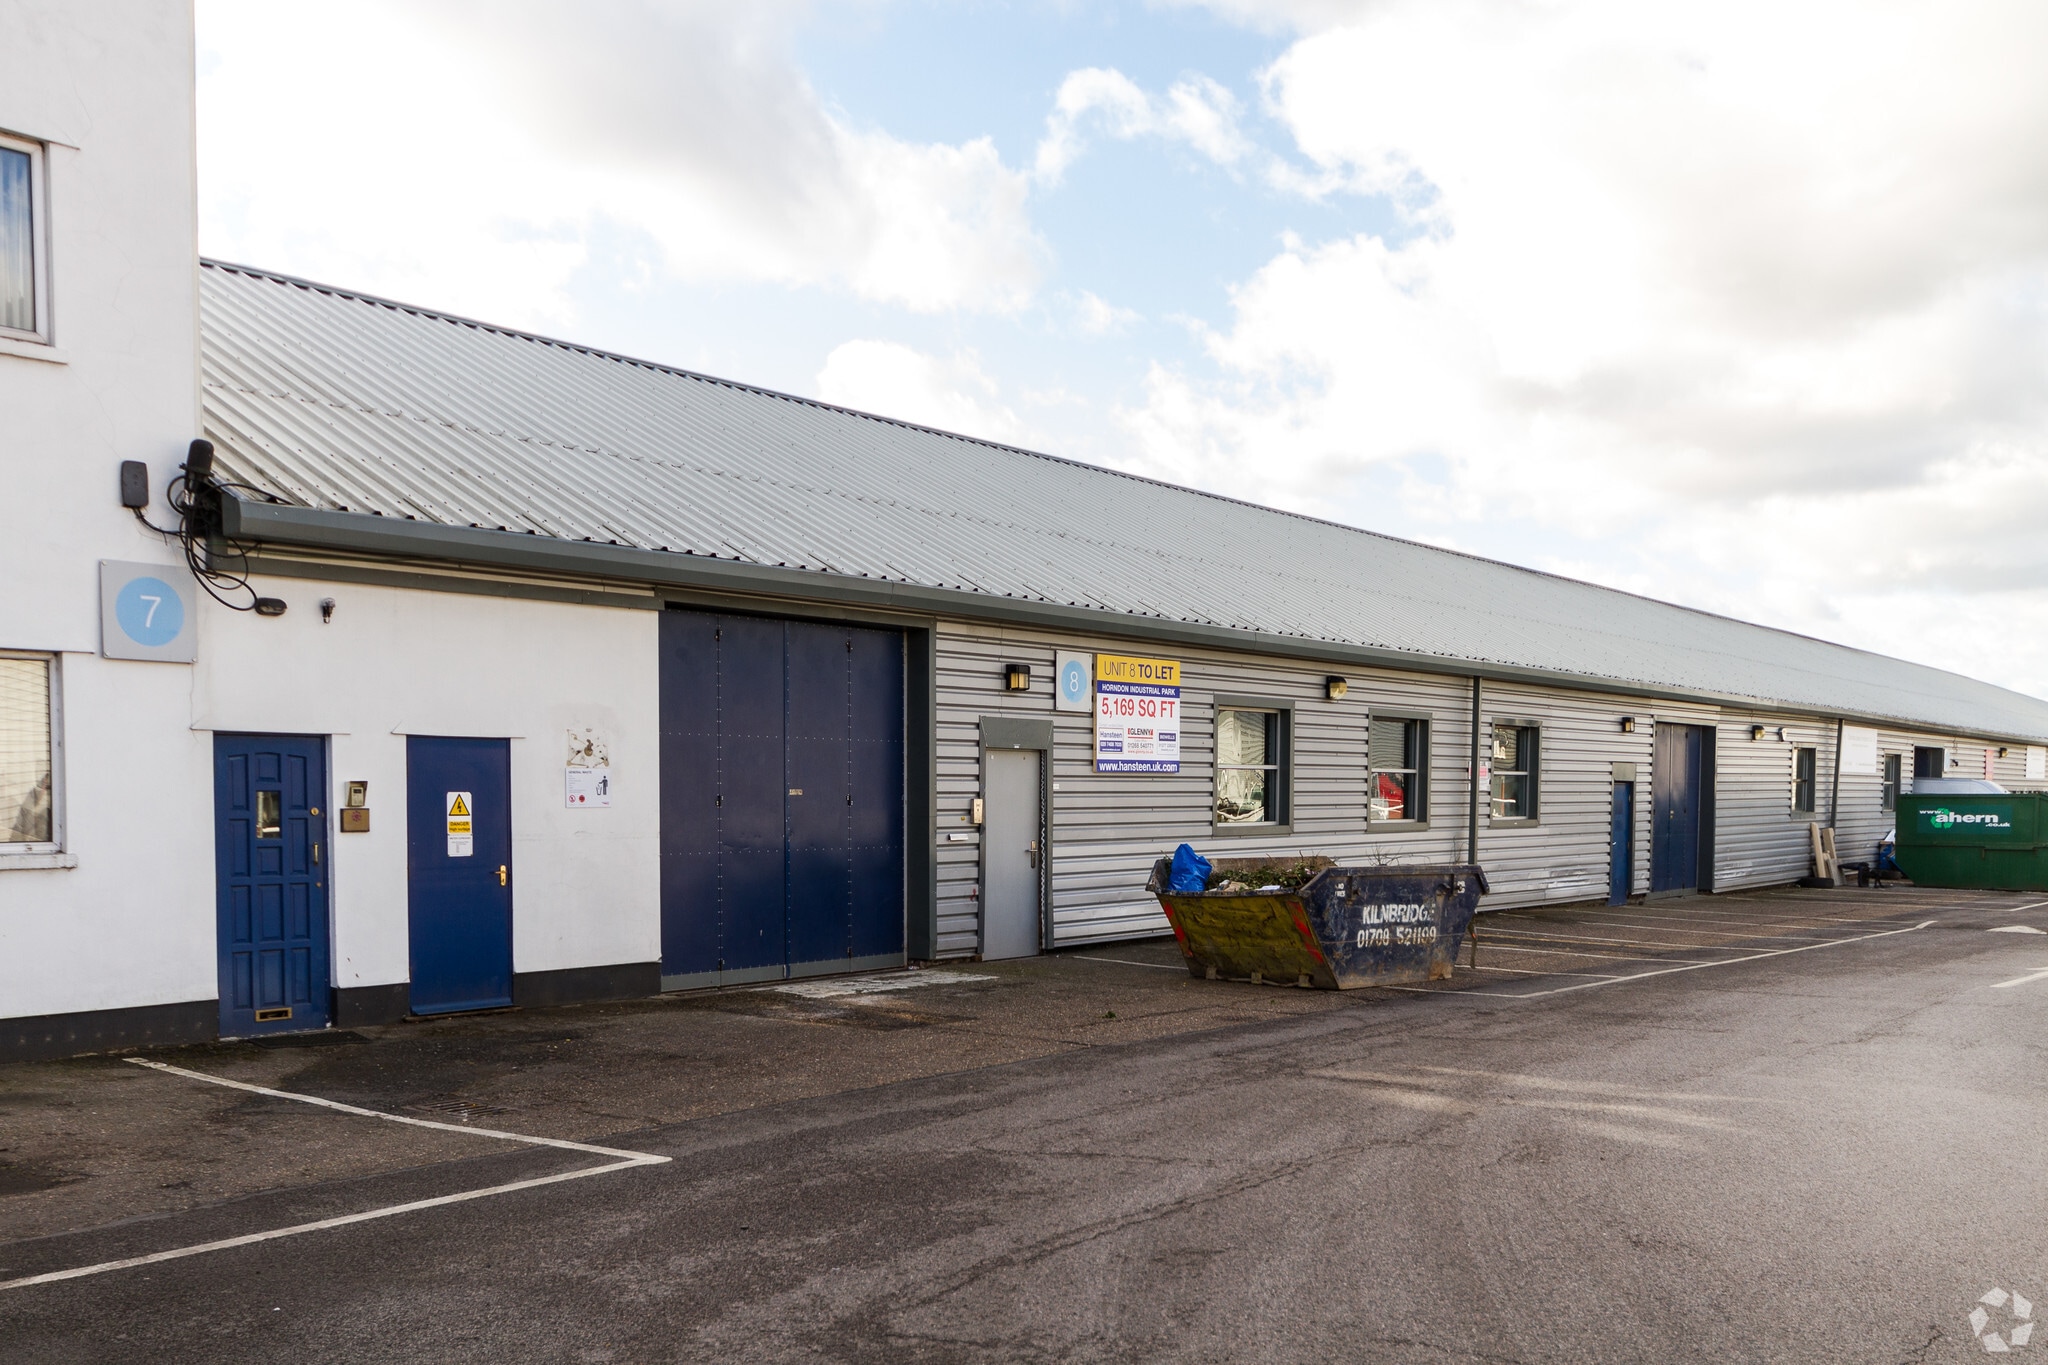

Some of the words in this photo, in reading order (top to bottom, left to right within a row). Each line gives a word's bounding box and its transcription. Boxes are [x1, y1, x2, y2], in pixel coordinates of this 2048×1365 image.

[140, 594, 162, 628] 7
[1104, 661, 1127, 676] UNIT
[1129, 663, 1136, 678] 8
[1138, 664, 1152, 679] TO
[1155, 665, 1174, 680] LET
[1069, 671, 1079, 692] 8
[1101, 683, 1129, 693] HORNDON
[1130, 685, 1161, 695] INDUSTRIAL
[1161, 688, 1176, 696] PARK
[1101, 697, 1135, 718] 5,169
[1138, 699, 1156, 718] SQ
[1160, 701, 1175, 718] FT
[1099, 730, 1123, 739] Hansteen
[1130, 728, 1151, 736] GLENNY
[1098, 761, 1178, 772] www.hansteen.uk.com
[1935, 812, 1999, 823] ahern
[1357, 927, 1390, 948] 01708
